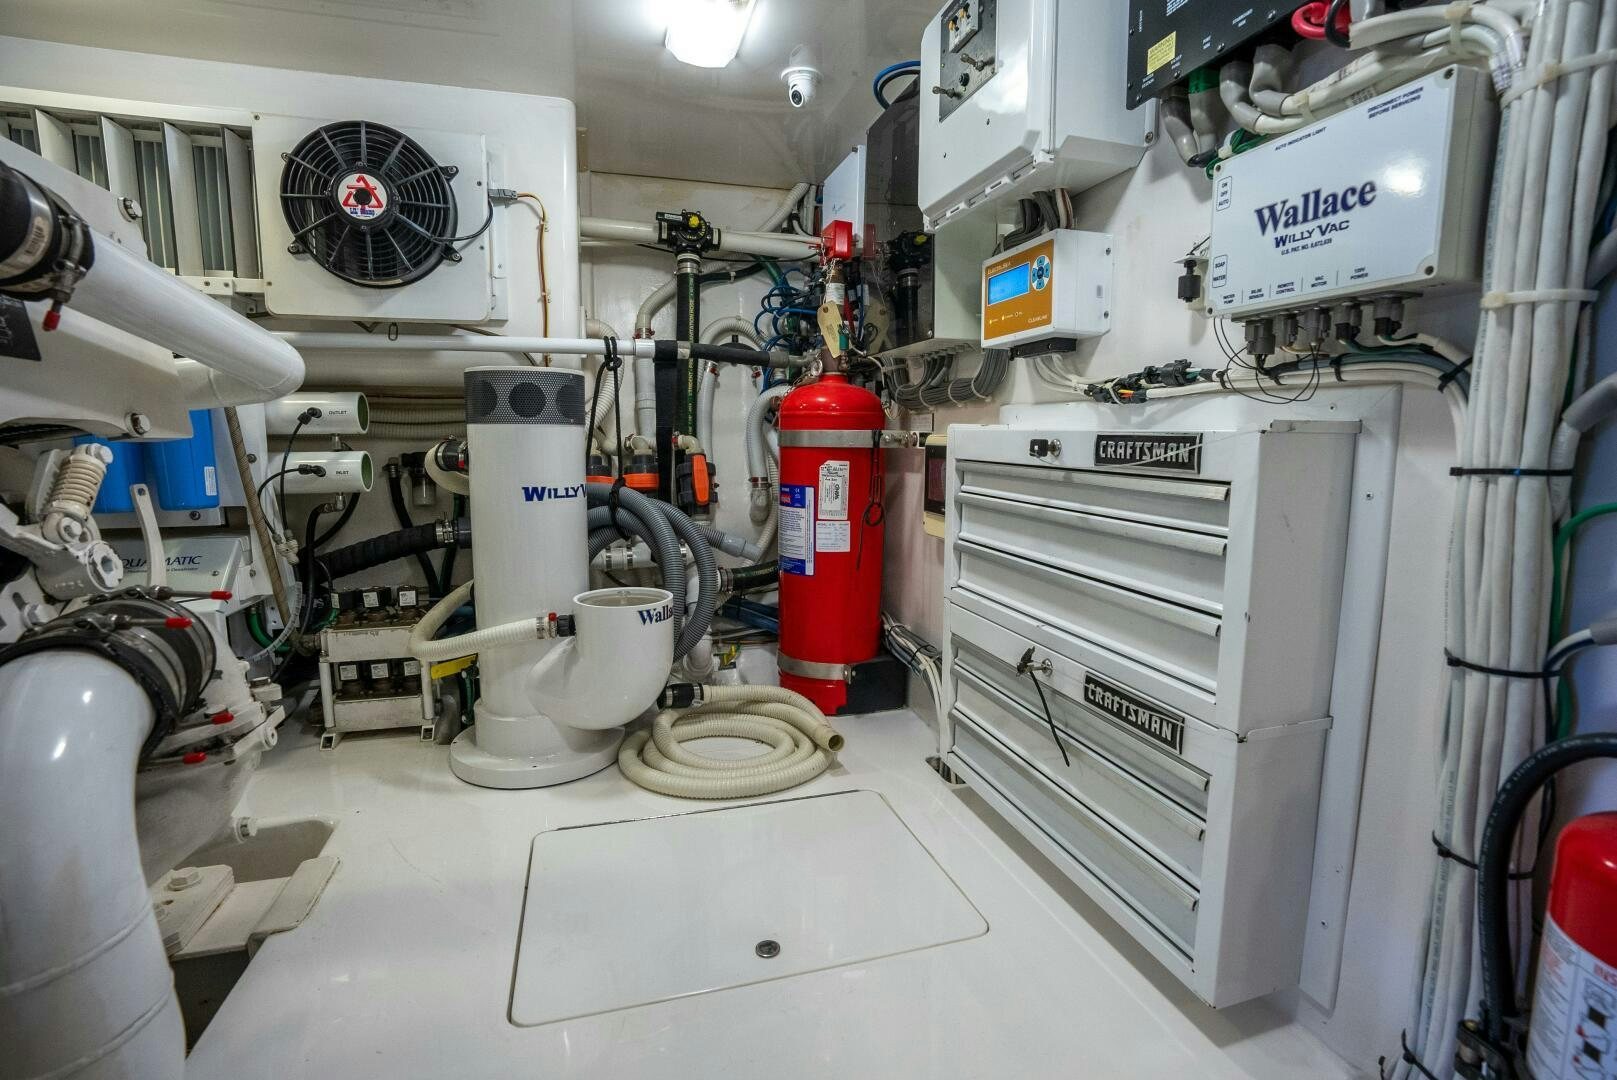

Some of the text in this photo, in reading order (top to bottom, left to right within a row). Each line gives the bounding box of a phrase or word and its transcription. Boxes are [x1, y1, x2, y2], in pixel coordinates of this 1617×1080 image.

[1254, 180, 1377, 237] Wallace
[1274, 220, 1350, 248] WILLY VAC
[1100, 440, 1190, 463] CRAFTSMAN
[637, 605, 673, 625] Walla
[1087, 683, 1173, 741] CRAFTSMAN
